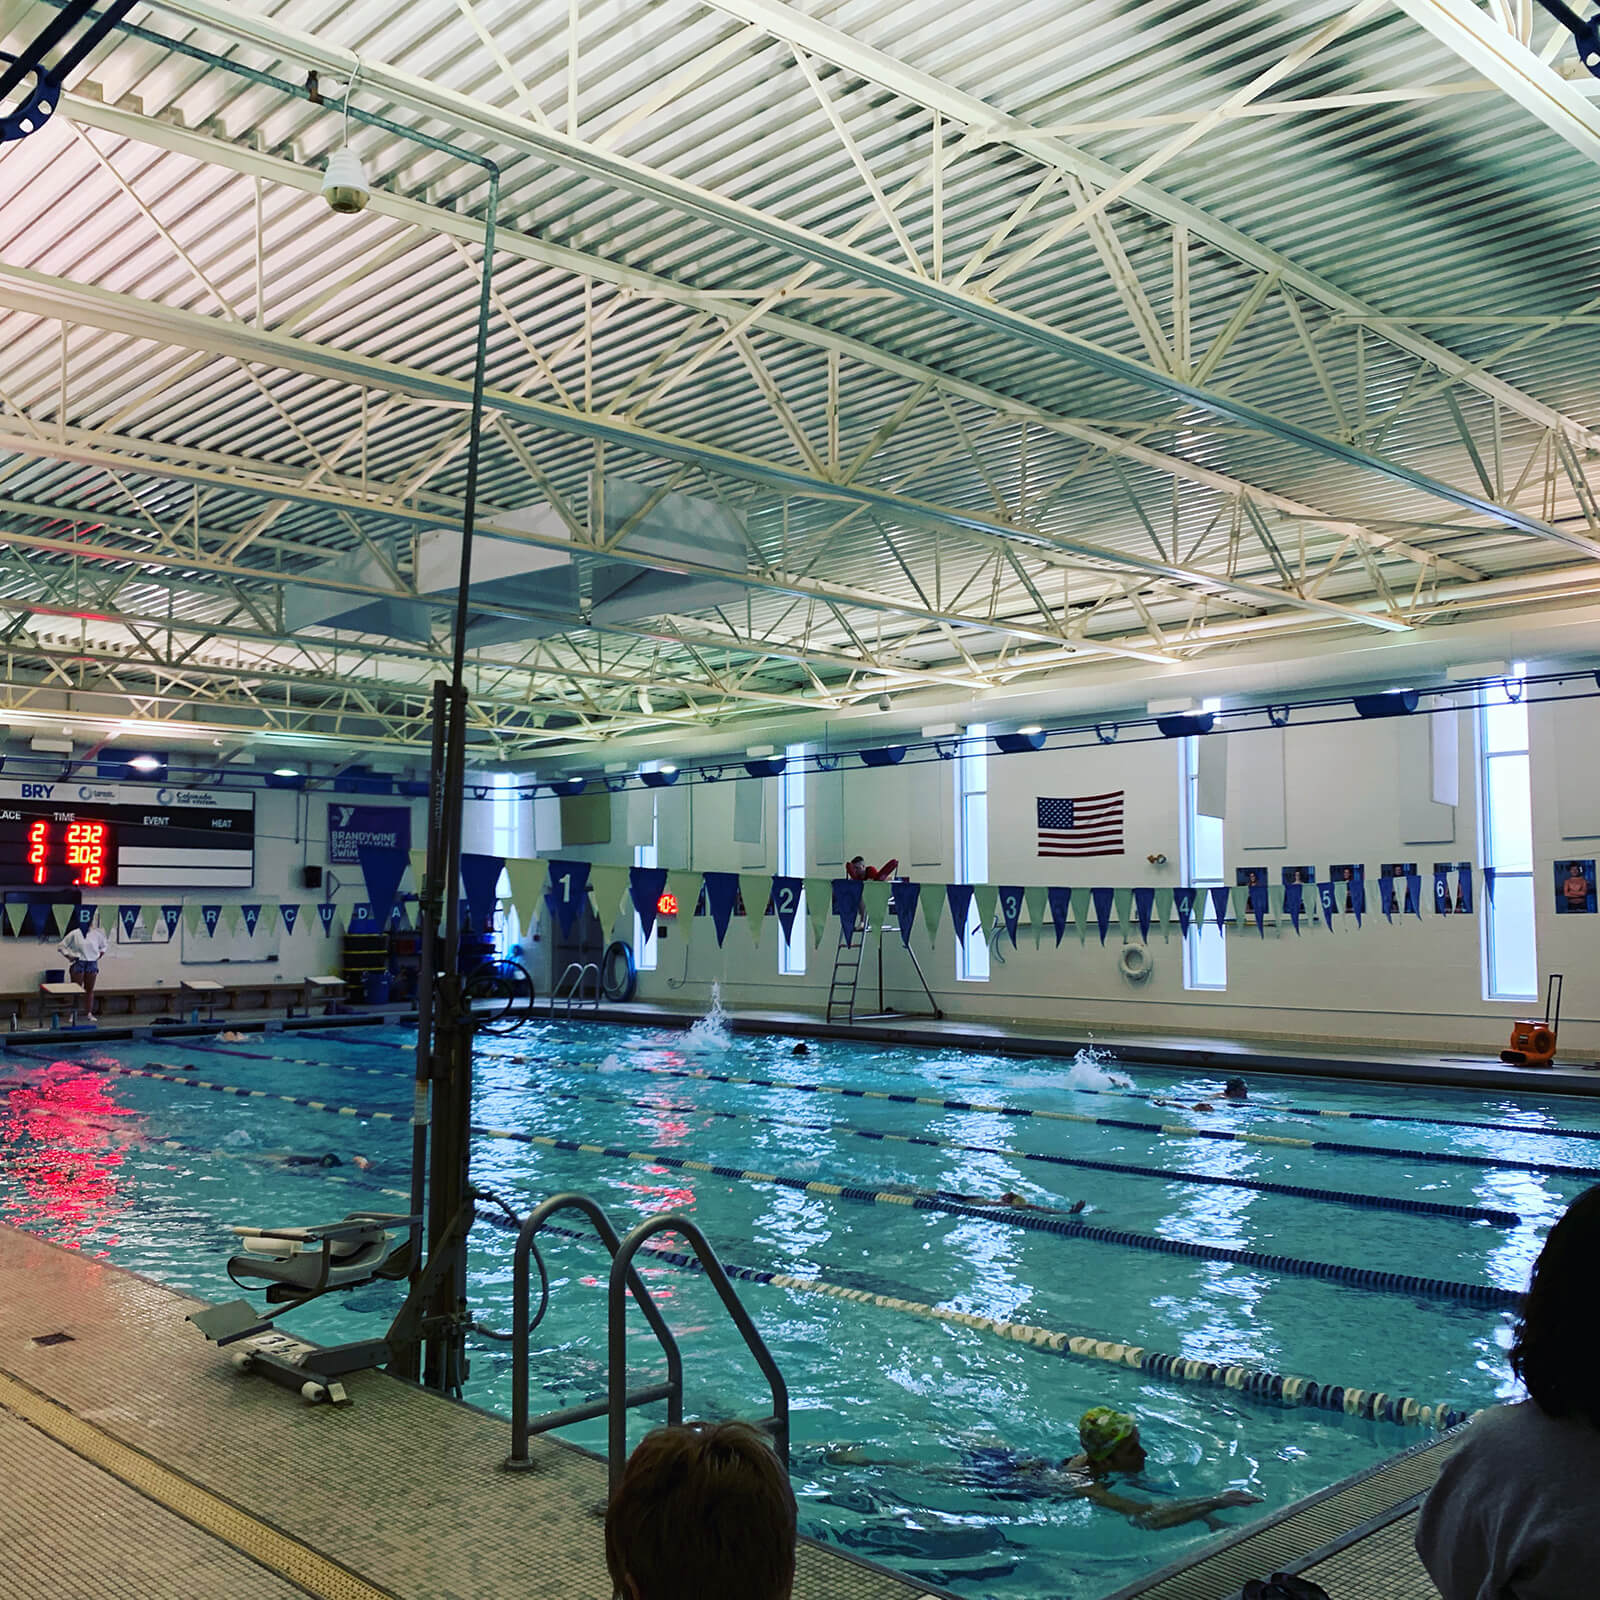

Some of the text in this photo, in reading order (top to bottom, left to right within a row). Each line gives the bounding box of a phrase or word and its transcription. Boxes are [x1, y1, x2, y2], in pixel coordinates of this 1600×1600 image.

[21, 783, 55, 799] BRY
[53, 811, 76, 822] TIME
[143, 816, 170, 826] EVENT
[211, 819, 233, 828] HEAT
[31, 823, 46, 842] 2
[332, 831, 397, 841] BRANDYWINE
[31, 844, 45, 863] 2
[332, 848, 359, 857] SWIM
[559, 873, 571, 903] 1
[1436, 880, 1445, 898] 6
[779, 887, 794, 914] 2
[1005, 896, 1018, 920] 3
[1179, 896, 1190, 916] 4
[1322, 890, 1332, 909] 5
